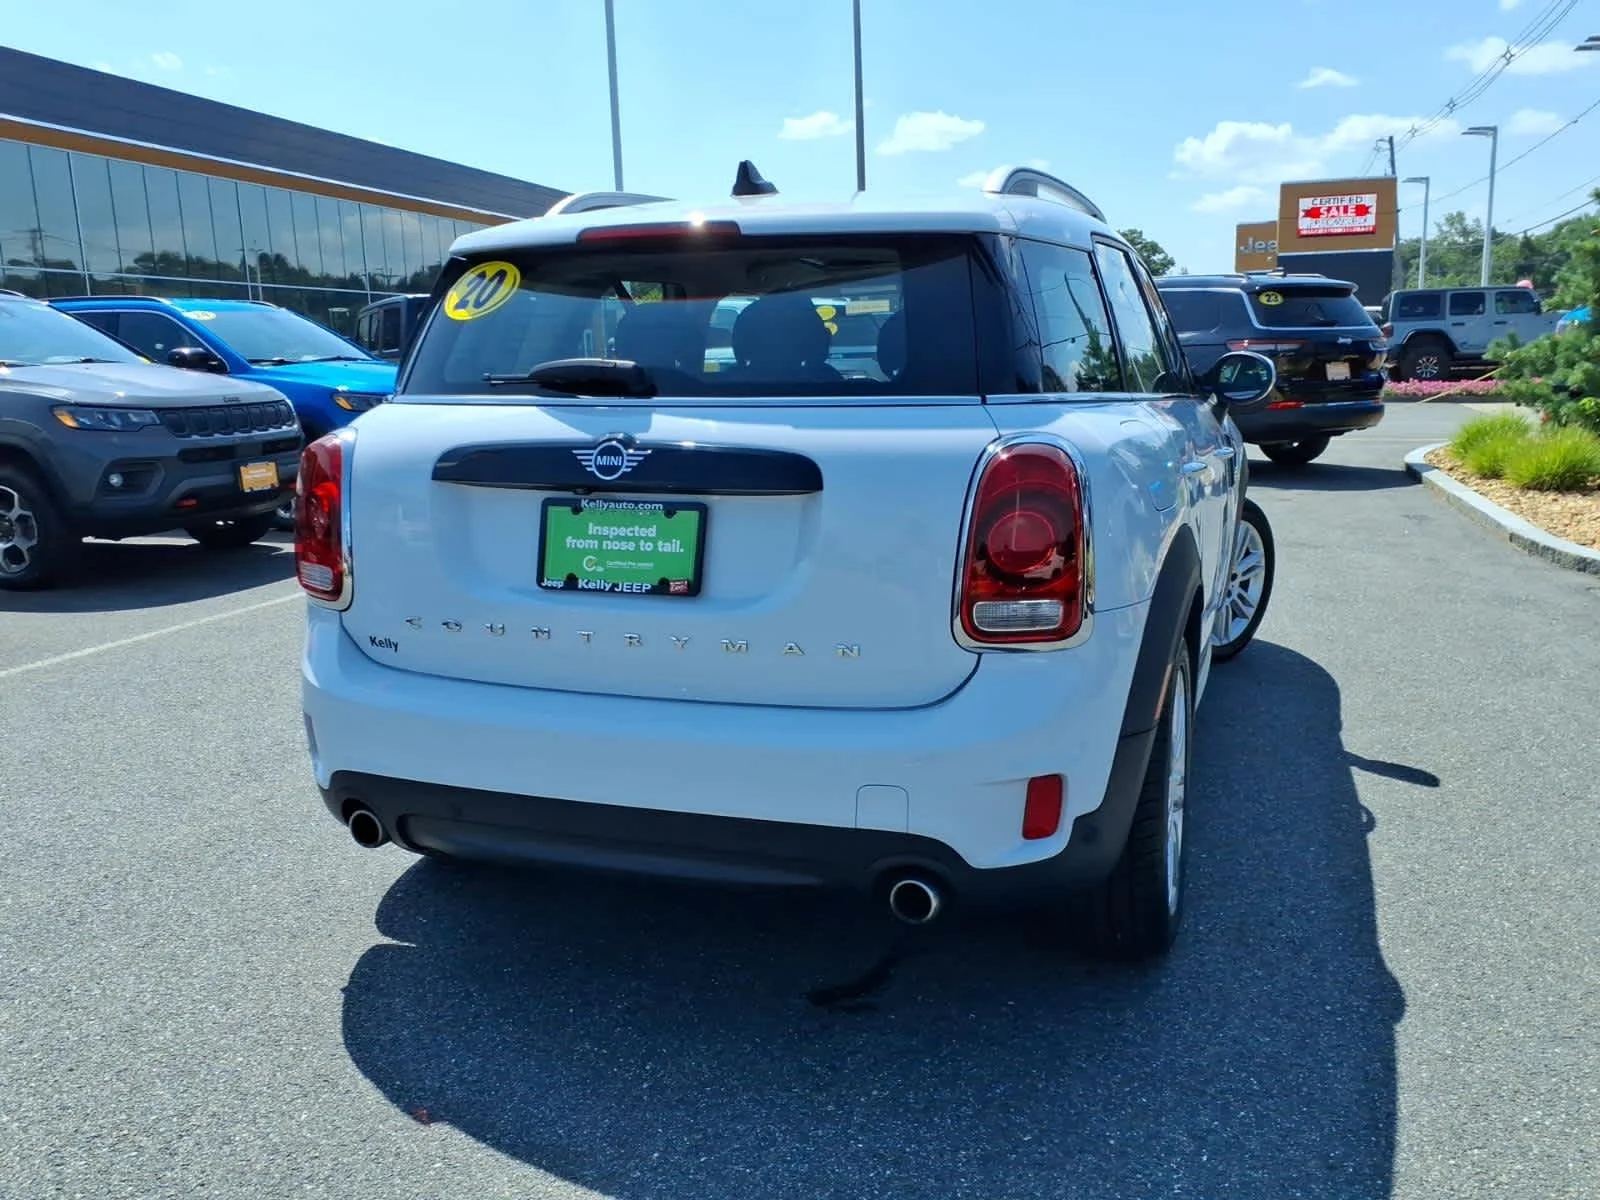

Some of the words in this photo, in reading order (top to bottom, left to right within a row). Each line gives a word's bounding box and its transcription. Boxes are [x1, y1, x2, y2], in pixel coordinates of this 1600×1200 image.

[1320, 204, 1357, 218] SALE
[453, 268, 508, 310] 20
[596, 455, 622, 467] MINI
[580, 499, 664, 511] Kellyauto.com
[588, 523, 657, 539] Inspected
[566, 536, 598, 550] from
[602, 540, 635, 552] nose
[639, 540, 654, 552] to
[658, 539, 685, 553] tail.
[541, 578, 564, 589] Jeep
[578, 578, 612, 593] Kelly
[614, 581, 652, 594] JEEP
[369, 635, 399, 653] Kelly
[405, 615, 861, 658] COUNTRYMAN
